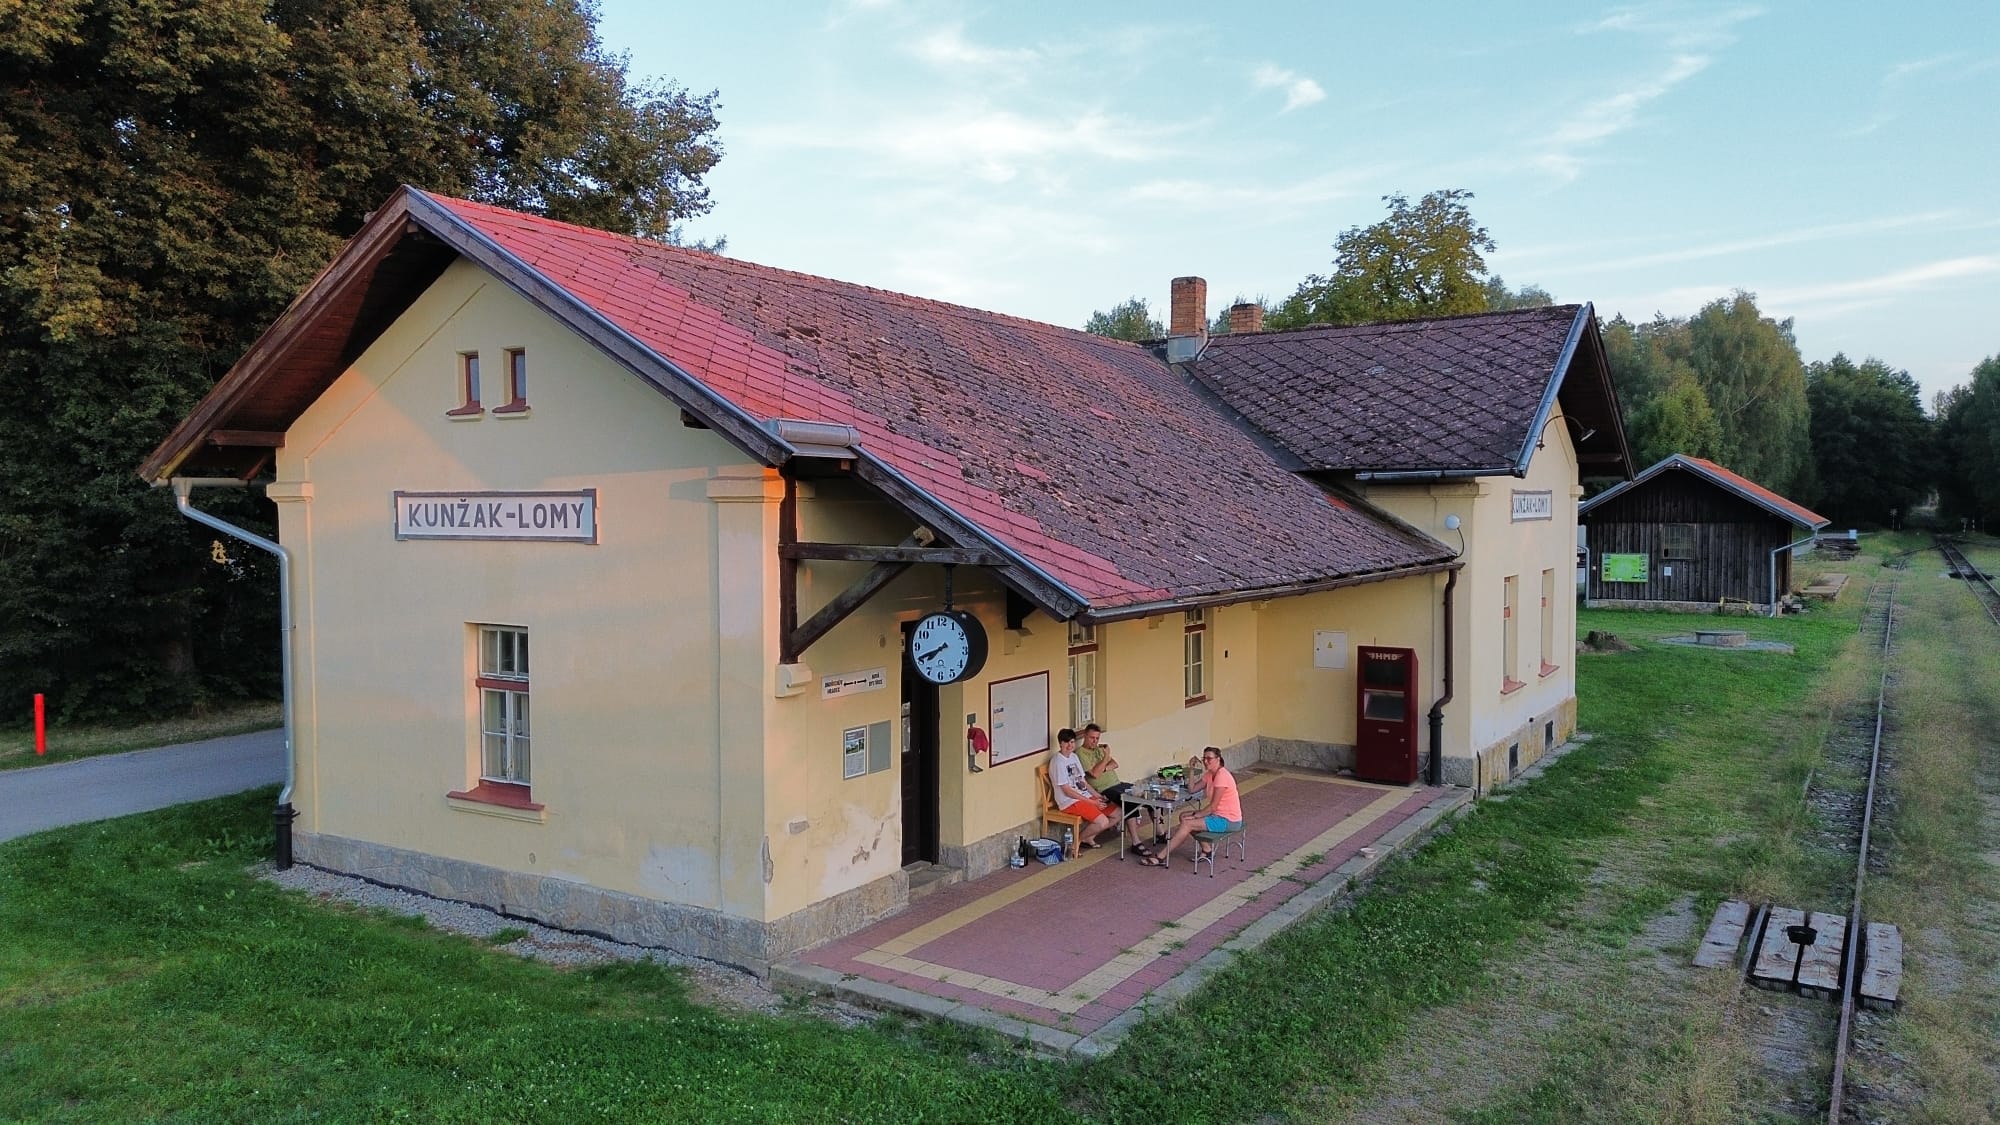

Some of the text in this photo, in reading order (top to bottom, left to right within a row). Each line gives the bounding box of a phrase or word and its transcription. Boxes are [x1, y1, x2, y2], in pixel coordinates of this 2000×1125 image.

[408, 498, 585, 529] KUNŽAK-LOMY
[926, 620, 935, 630] 11
[937, 616, 947, 627] 12
[919, 630, 929, 640] 10
[958, 631, 965, 641] 2
[914, 642, 921, 652] 9
[962, 646, 968, 656] 3
[957, 659, 964, 669] 4
[926, 666, 932, 676] 7
[937, 671, 944, 681] 6
[949, 668, 956, 678] 5
